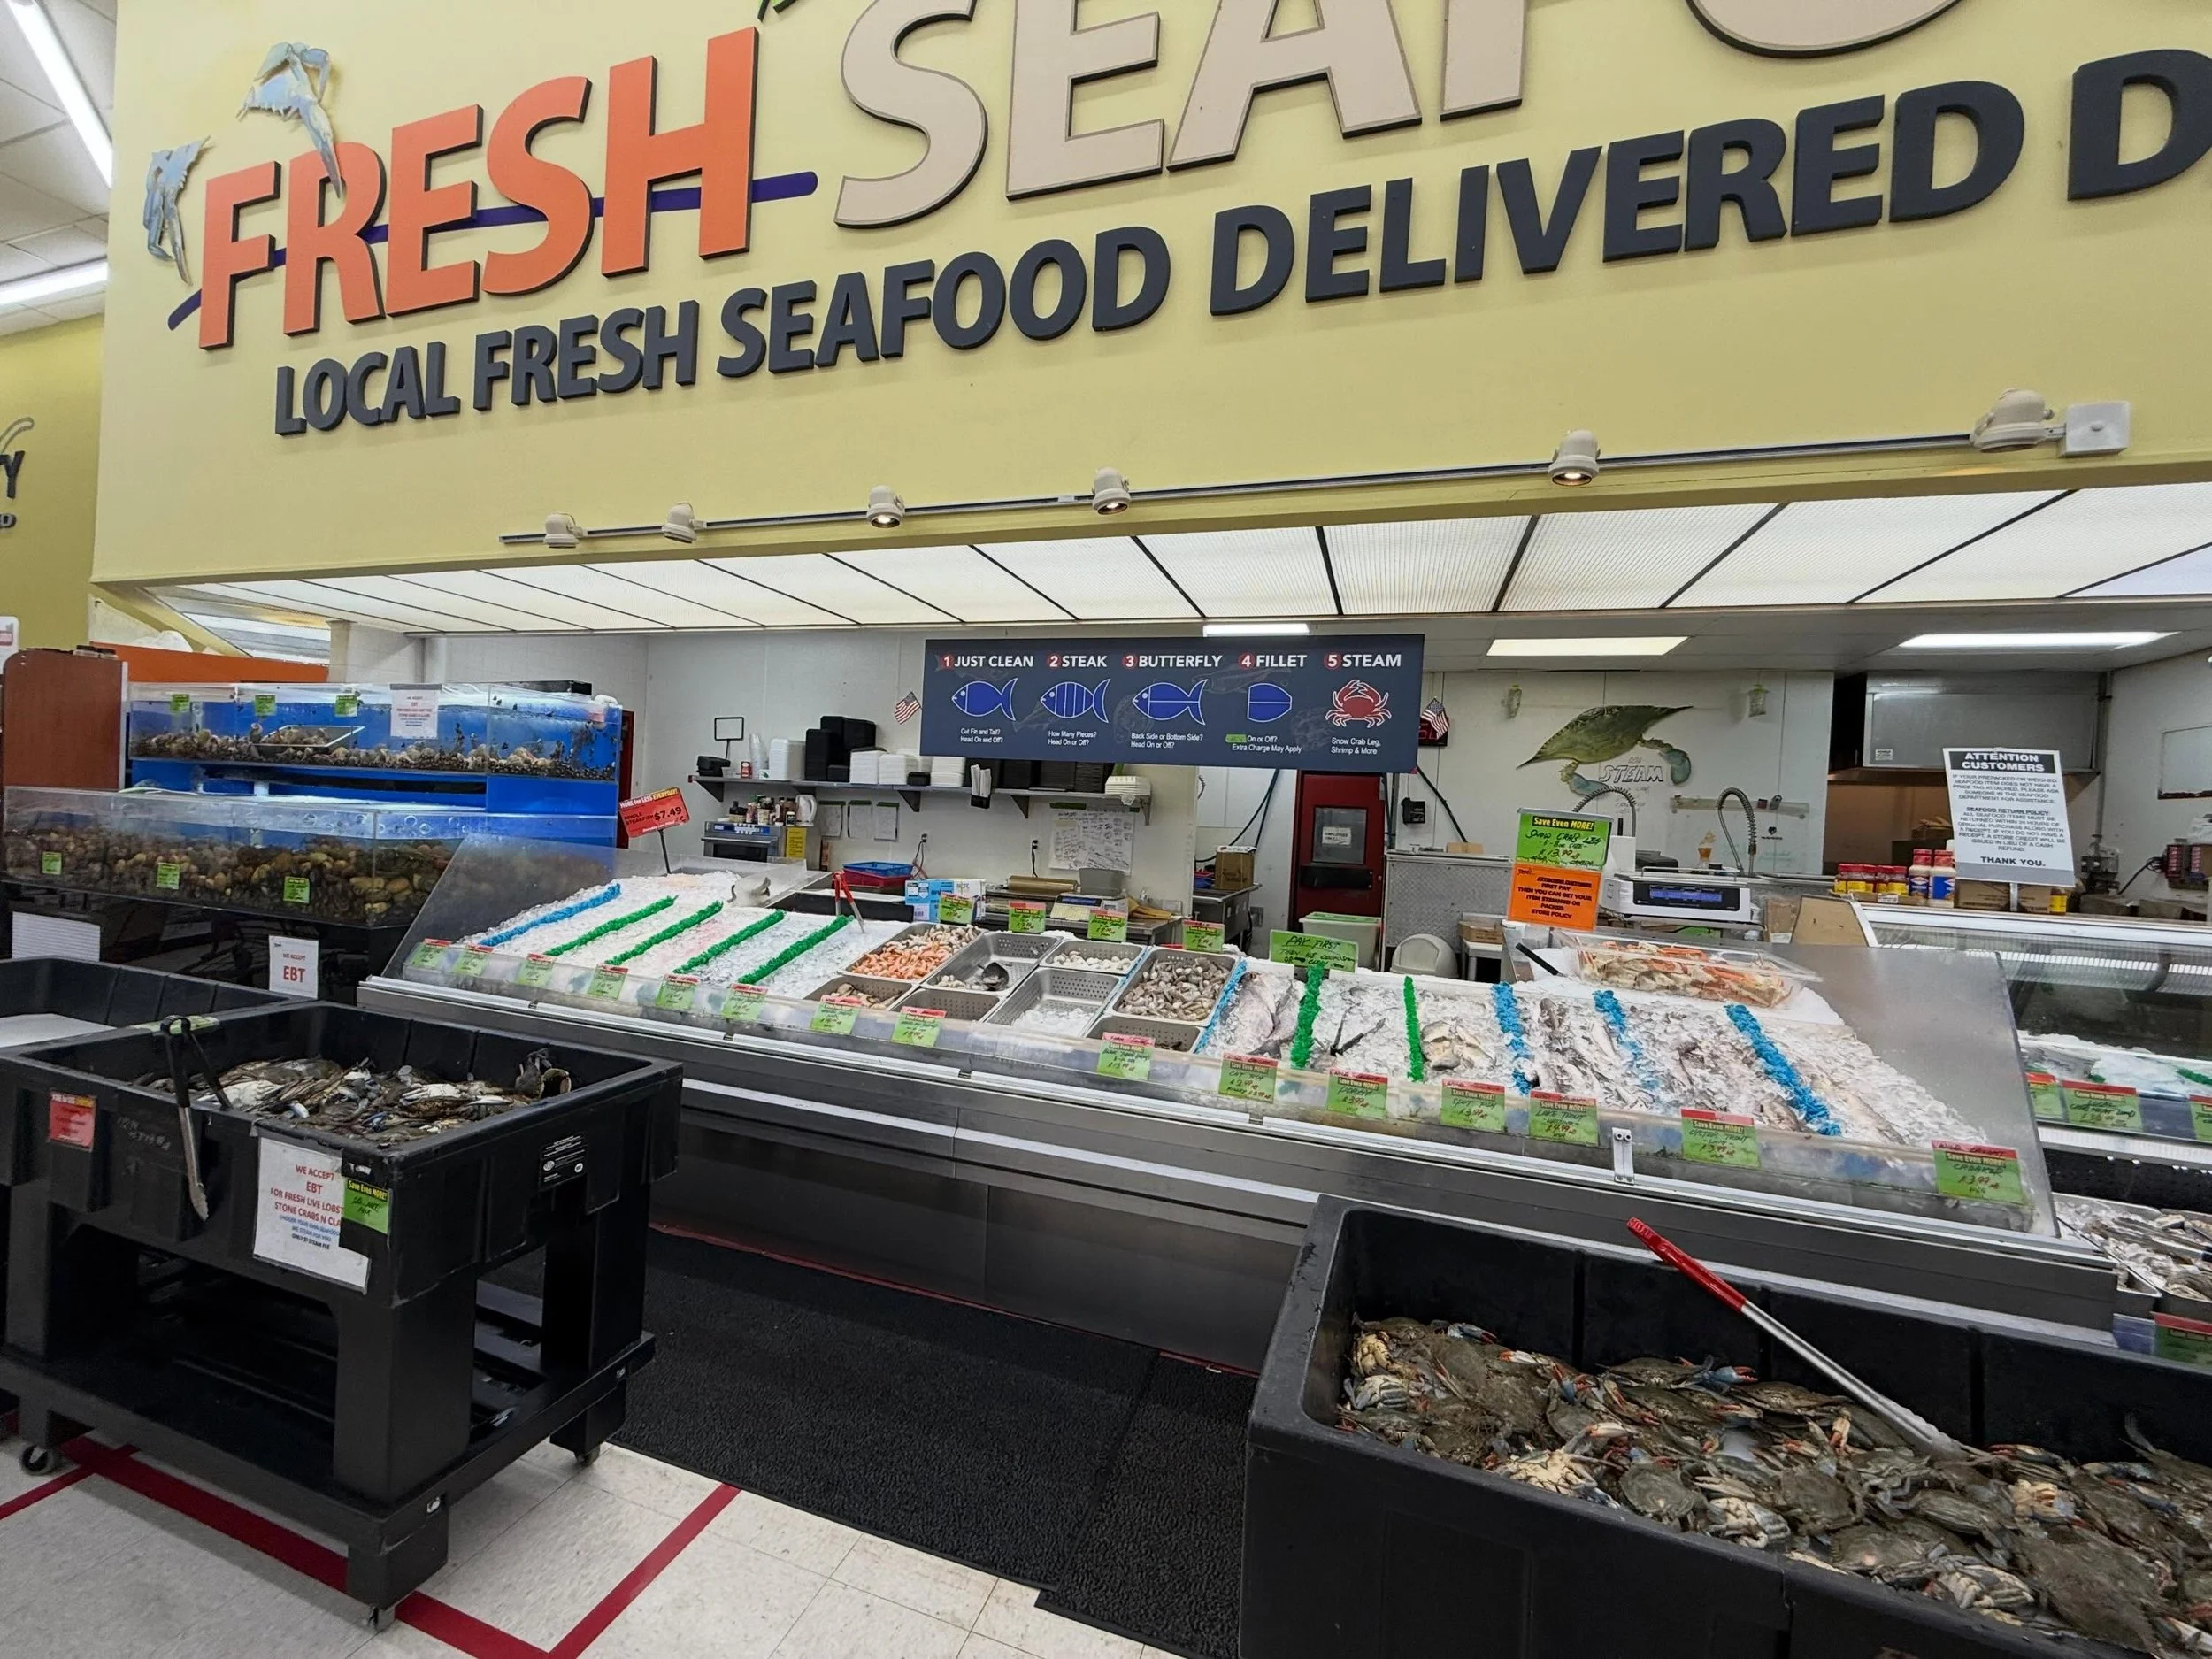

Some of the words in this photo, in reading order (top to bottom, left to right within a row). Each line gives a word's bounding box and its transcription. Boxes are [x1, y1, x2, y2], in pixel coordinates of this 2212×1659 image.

[199, 27, 759, 350] FRESH
[275, 341, 461, 436] LOCAL
[472, 300, 700, 411] FRESH
[717, 226, 1171, 379] SEAFOOD
[1210, 80, 2024, 316] DELIVERED
[954, 655, 986, 668] JUST
[988, 655, 1033, 668] CLEAN
[1049, 656, 1058, 668] 2
[1062, 655, 1107, 668] STEAK
[1125, 655, 1134, 668] 3
[1139, 655, 1223, 668] BUTTERFLY
[1241, 655, 1251, 668] 4
[1256, 654, 1307, 668] FILLET
[1327, 654, 1337, 668] 5
[1342, 654, 1402, 668] STEAM
[1248, 744, 1270, 753] Charge
[1271, 745, 1284, 754] May
[1285, 745, 1302, 755] Apply
[1367, 739, 1381, 748] Leg,
[1964, 752, 2039, 762] ATTENTION
[1961, 761, 2045, 772] CUSTOMERS
[1599, 764, 1664, 784] STEAM
[619, 799, 634, 809] MORE
[654, 807, 682, 821] $7.49
[1533, 817, 1551, 826] Save
[1551, 818, 1570, 828] Even
[1570, 820, 1594, 830] MORE!
[1980, 856, 2017, 865] THANK
[2020, 858, 2046, 867] YOU.
[1286, 935, 1310, 946] PAY
[1310, 940, 1340, 951] FIRST
[283, 965, 306, 983] EBT
[1947, 1152, 1963, 1161] Save
[1964, 1155, 1982, 1164] Even
[1982, 1158, 2005, 1167] MORE!
[296, 1164, 307, 1175] WE
[308, 1168, 335, 1180] ACCEPT
[306, 1181, 324, 1194] EBT
[348, 1179, 360, 1191] Save
[360, 1183, 372, 1195] Even
[372, 1188, 388, 1202] MORE!
[270, 1187, 283, 1198] FOR
[284, 1191, 305, 1204] FRESH
[306, 1197, 320, 1209] LIVE
[274, 1202, 296, 1214] STONE
[298, 1208, 319, 1221] CRABS
